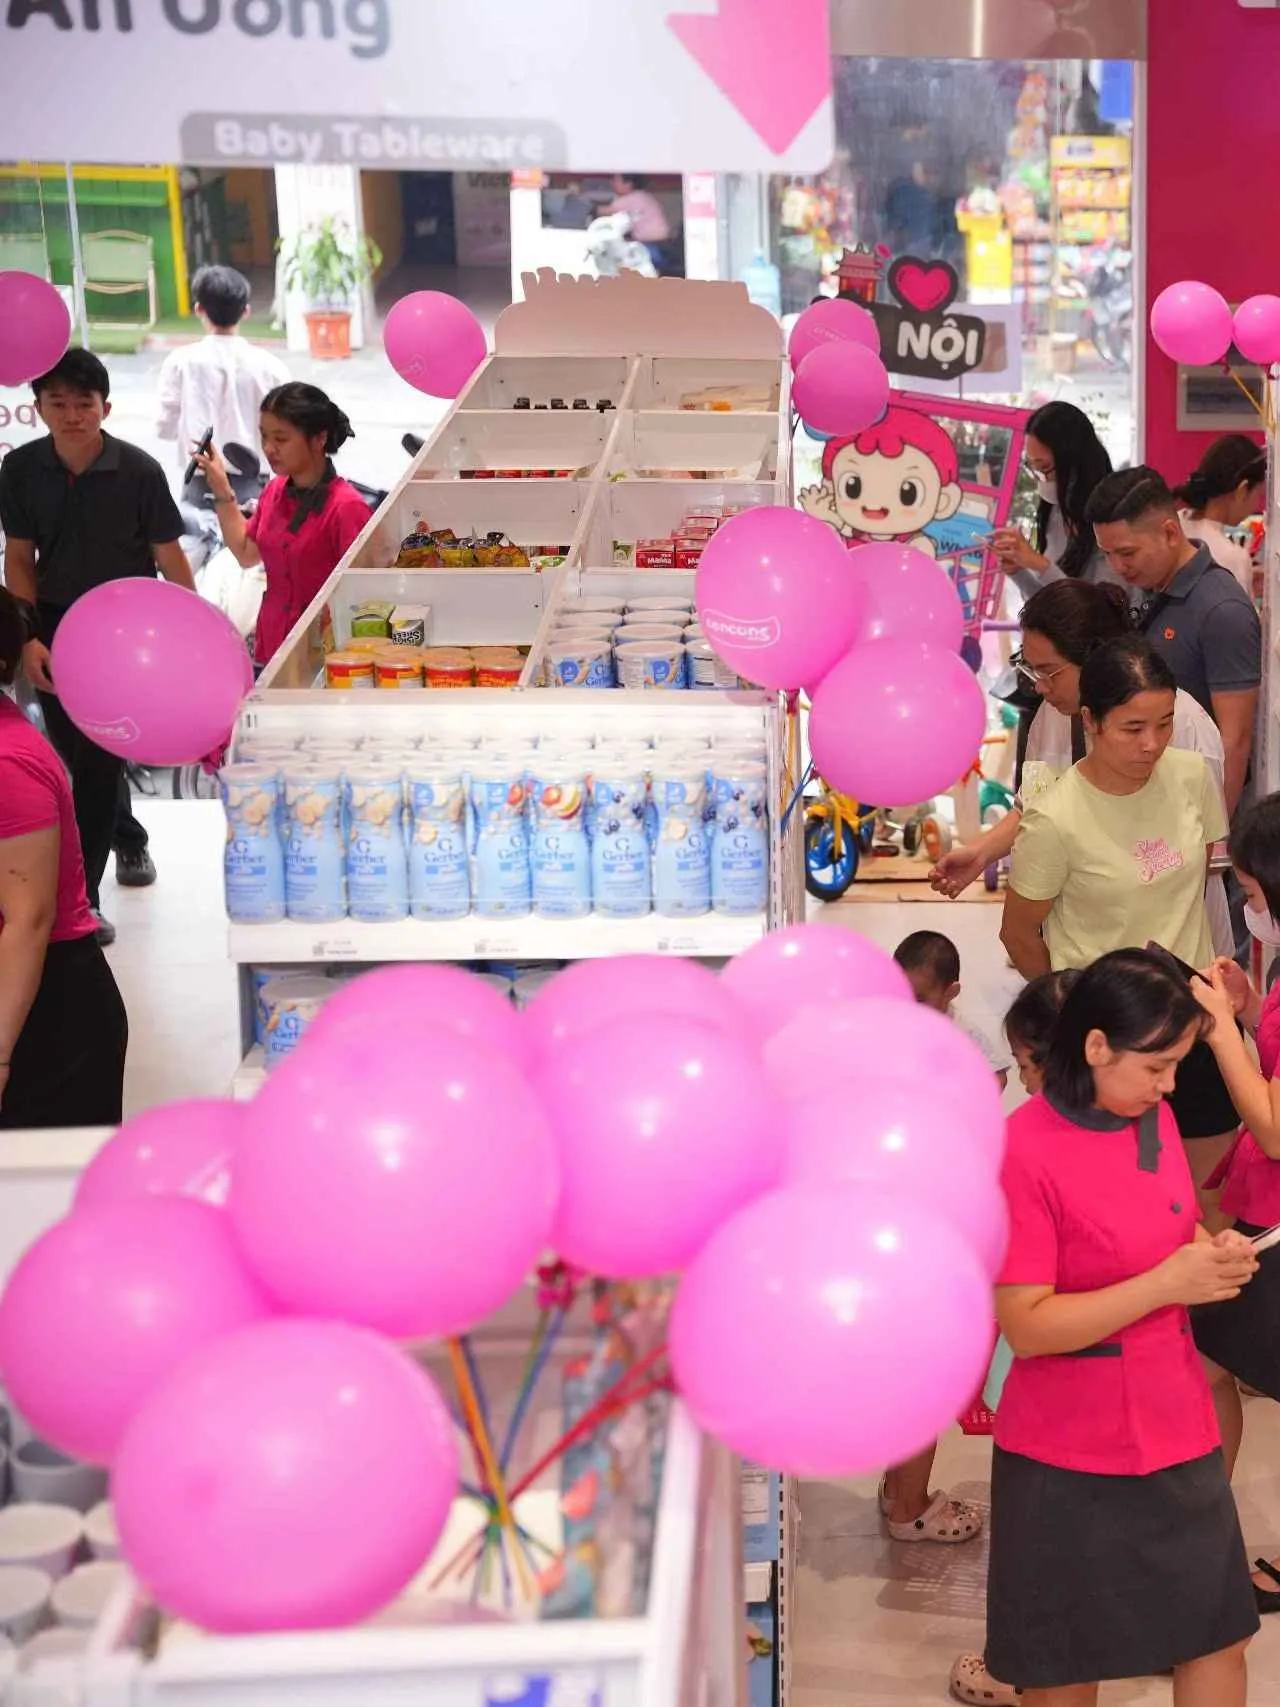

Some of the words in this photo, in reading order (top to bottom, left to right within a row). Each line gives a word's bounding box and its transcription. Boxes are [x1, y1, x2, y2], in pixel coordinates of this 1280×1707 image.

[214, 119, 324, 160] Baby
[333, 124, 546, 161] Tableware
[897, 318, 979, 371] NỘI
